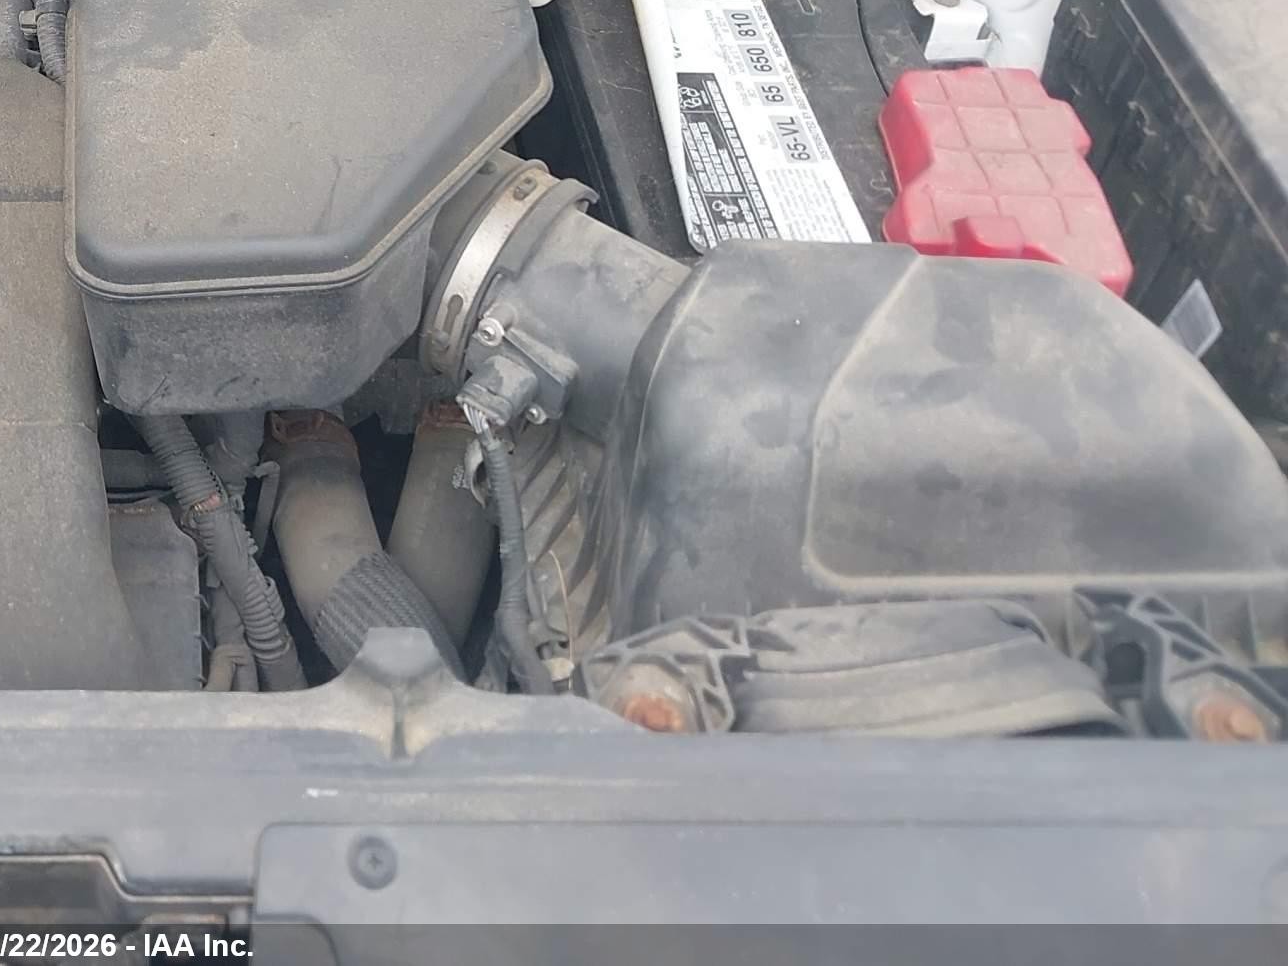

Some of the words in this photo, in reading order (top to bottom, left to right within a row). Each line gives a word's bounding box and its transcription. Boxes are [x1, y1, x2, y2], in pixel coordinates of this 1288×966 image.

[731, 13, 757, 37] 810
[746, 47, 772, 72] 650
[762, 85, 784, 103] 65
[777, 117, 810, 161] 65-VL
